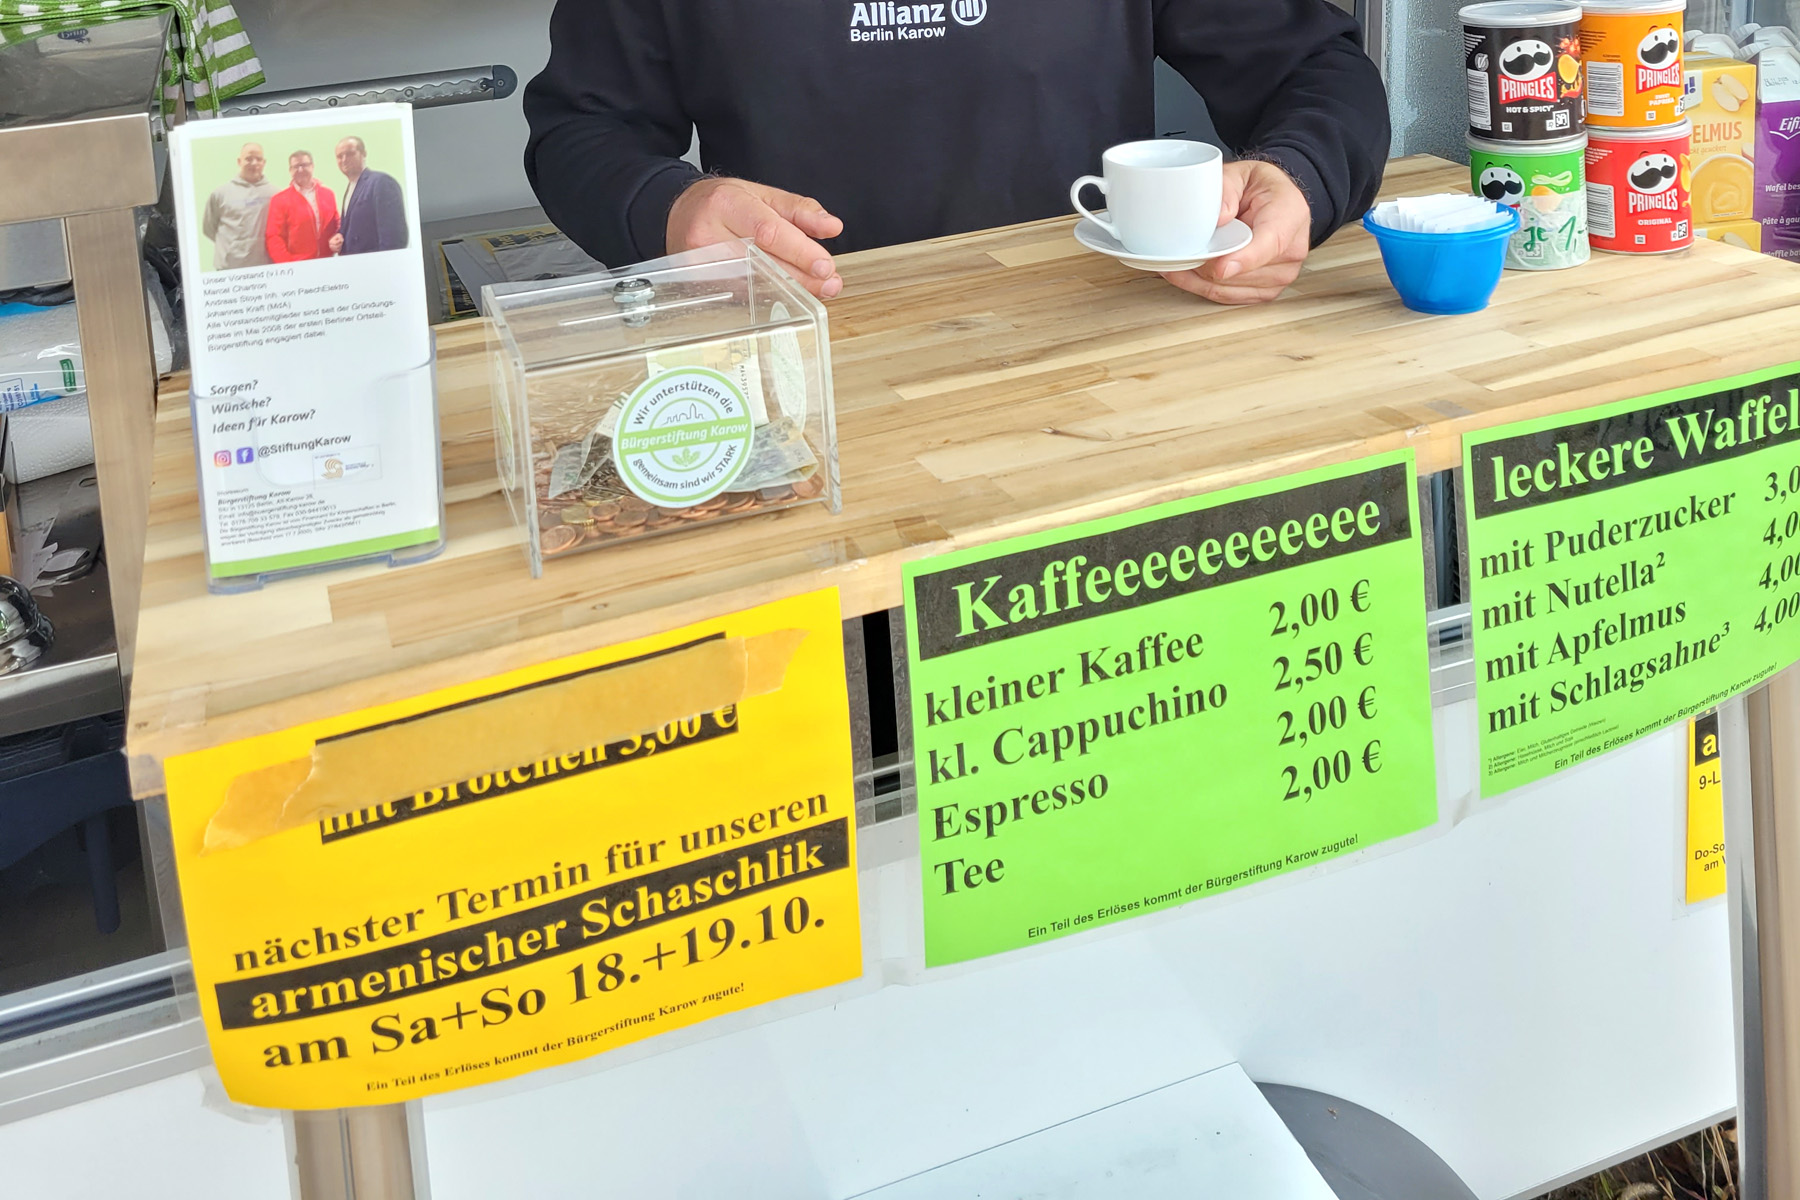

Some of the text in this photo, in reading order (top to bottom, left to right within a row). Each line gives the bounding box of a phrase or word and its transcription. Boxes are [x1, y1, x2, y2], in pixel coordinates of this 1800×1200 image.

[850, 2, 946, 27] Allianz
[850, 26, 946, 42] Berlin Karow
[1500, 76, 1555, 101] PRINGLES
[1637, 62, 1680, 91] PRINGLES
[1529, 105, 1554, 113] SPICY
[1649, 98, 1675, 106] PAPRIKA
[1692, 120, 1743, 144] ELMUS
[1628, 188, 1678, 214] PRINGLES
[1765, 183, 1787, 192] Wafel
[1637, 218, 1673, 226] ORIGINAL
[336, 304, 350, 312] der
[283, 321, 297, 330] der
[209, 379, 259, 397] Sorgen?
[211, 397, 272, 415] Wünsche?
[633, 380, 735, 426] Wir unterstützen die
[212, 409, 317, 435] Ideen für Karow?
[257, 434, 352, 459] @StiftungKarow
[620, 423, 748, 450] Bürgerstiftung Karow
[1490, 386, 1800, 504] leckere Waffel
[632, 444, 738, 490] gemeinsam sind wir STARK
[1478, 538, 1536, 580] mit
[1544, 490, 1738, 566] Puderzucker
[952, 500, 1382, 638] Kaffeeeeeeeeeee
[1481, 588, 1537, 632] mit
[1762, 510, 1800, 549] 4,0
[923, 578, 1373, 729] kleiner Kaffee 2,00 €
[1484, 641, 1540, 683] mit
[1545, 599, 1688, 669] Apfelmus
[1487, 692, 1542, 735] mit
[1752, 590, 1800, 635] 4,00
[927, 631, 1375, 787] kl. Cappuchino 2,50 €
[1554, 661, 1778, 770] Ein Teil des Erlöses kommt der Bürgerstiftung Karow zugute!
[931, 684, 1379, 843] Espresso 2,00 €
[1699, 770, 1722, 790] 9-L
[933, 738, 1384, 897] Tee 2,00 €
[1694, 842, 1726, 861] Do-So
[1703, 860, 1720, 872] am
[233, 792, 830, 974] nächster Termin für unseren
[1027, 833, 1360, 939] Ein Teil des Erlöses kommt der Bürgerstiftung Karow zugute!
[251, 837, 827, 1021] armenischer Schaschlik
[263, 894, 827, 1070] am Sa+So 18.+19.10.
[366, 981, 746, 1092] Ein Teil des Erlöses kommt der Bürgerstiftung Karow zugute!
